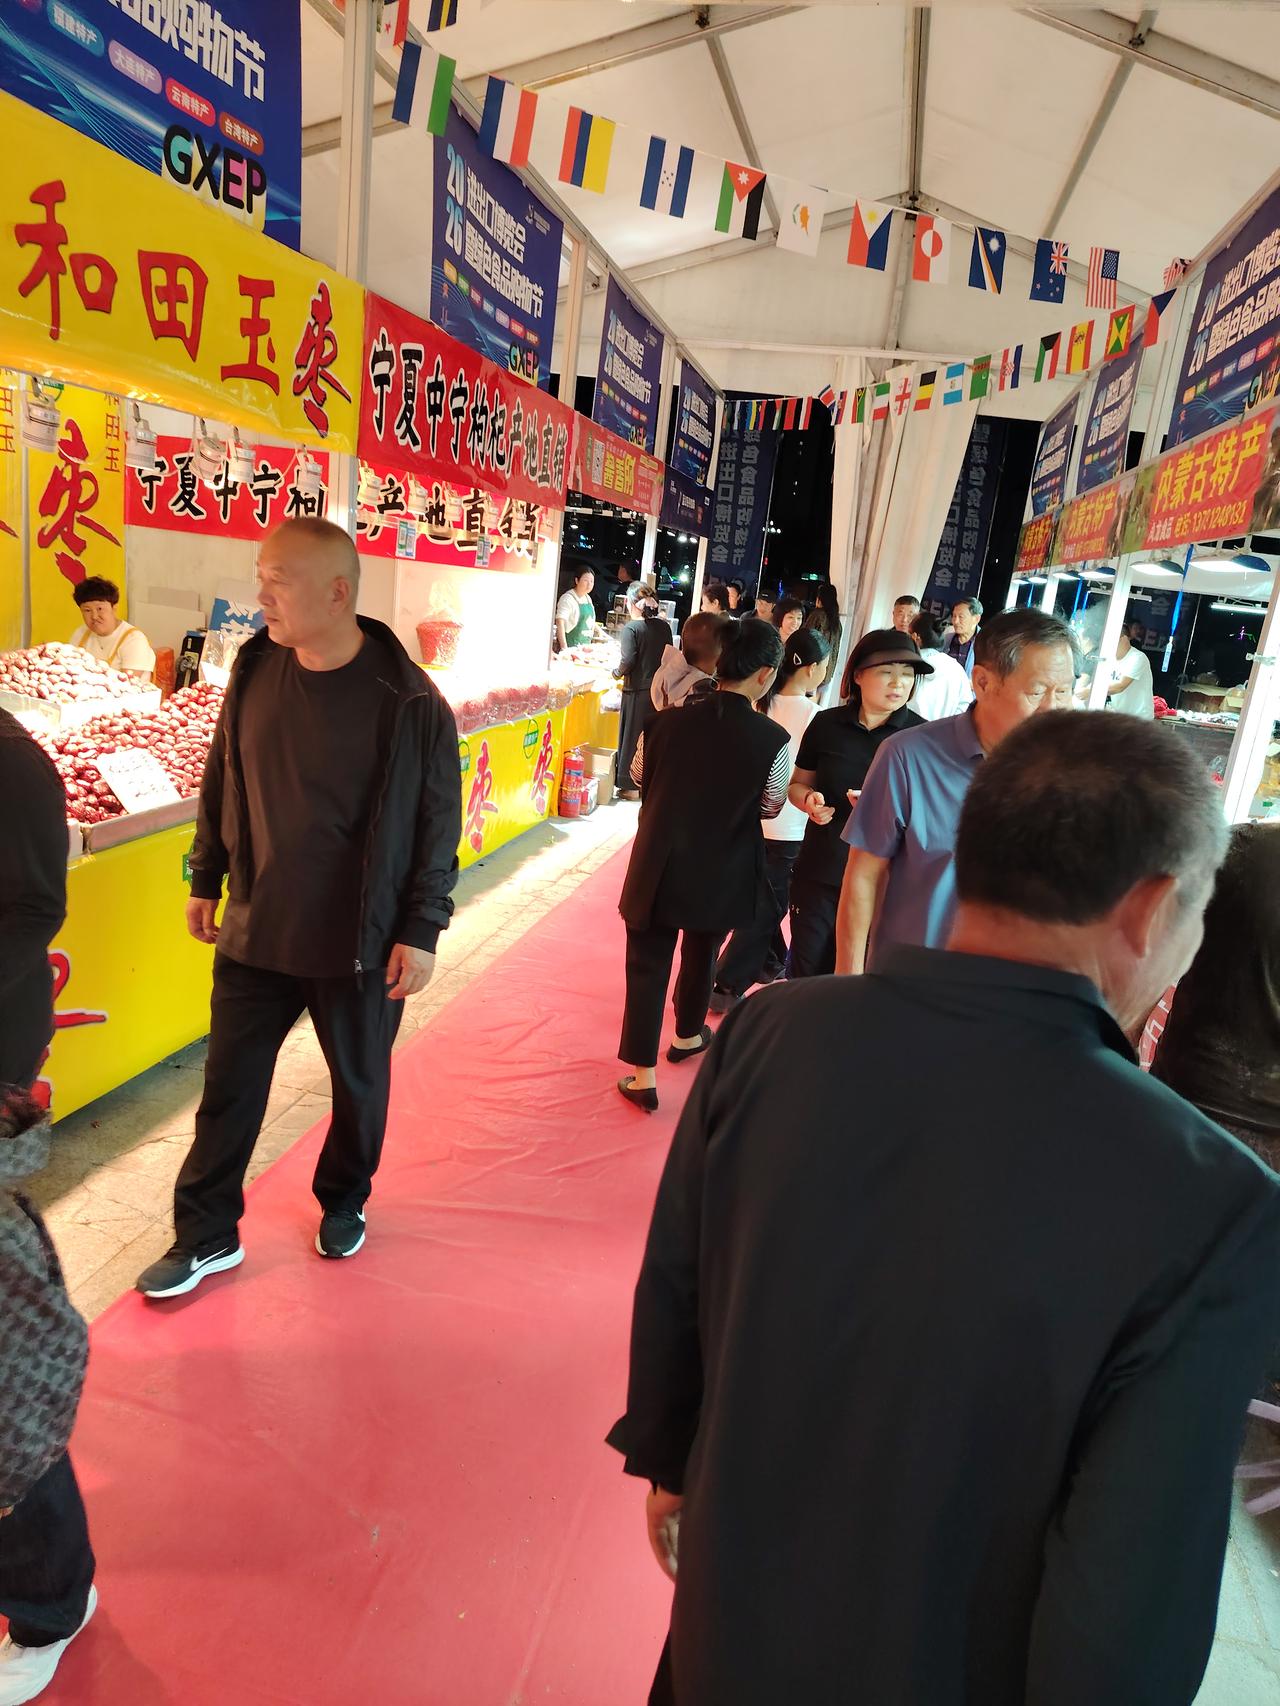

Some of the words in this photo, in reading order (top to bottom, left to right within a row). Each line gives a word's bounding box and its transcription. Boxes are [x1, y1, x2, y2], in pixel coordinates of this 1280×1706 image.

[171, 86, 210, 117] 云南特产
[163, 125, 266, 214] GXEP
[368, 326, 569, 497] 宁夏中宁枸杞产地直销
[1154, 420, 1266, 515] 内蒙古特产
